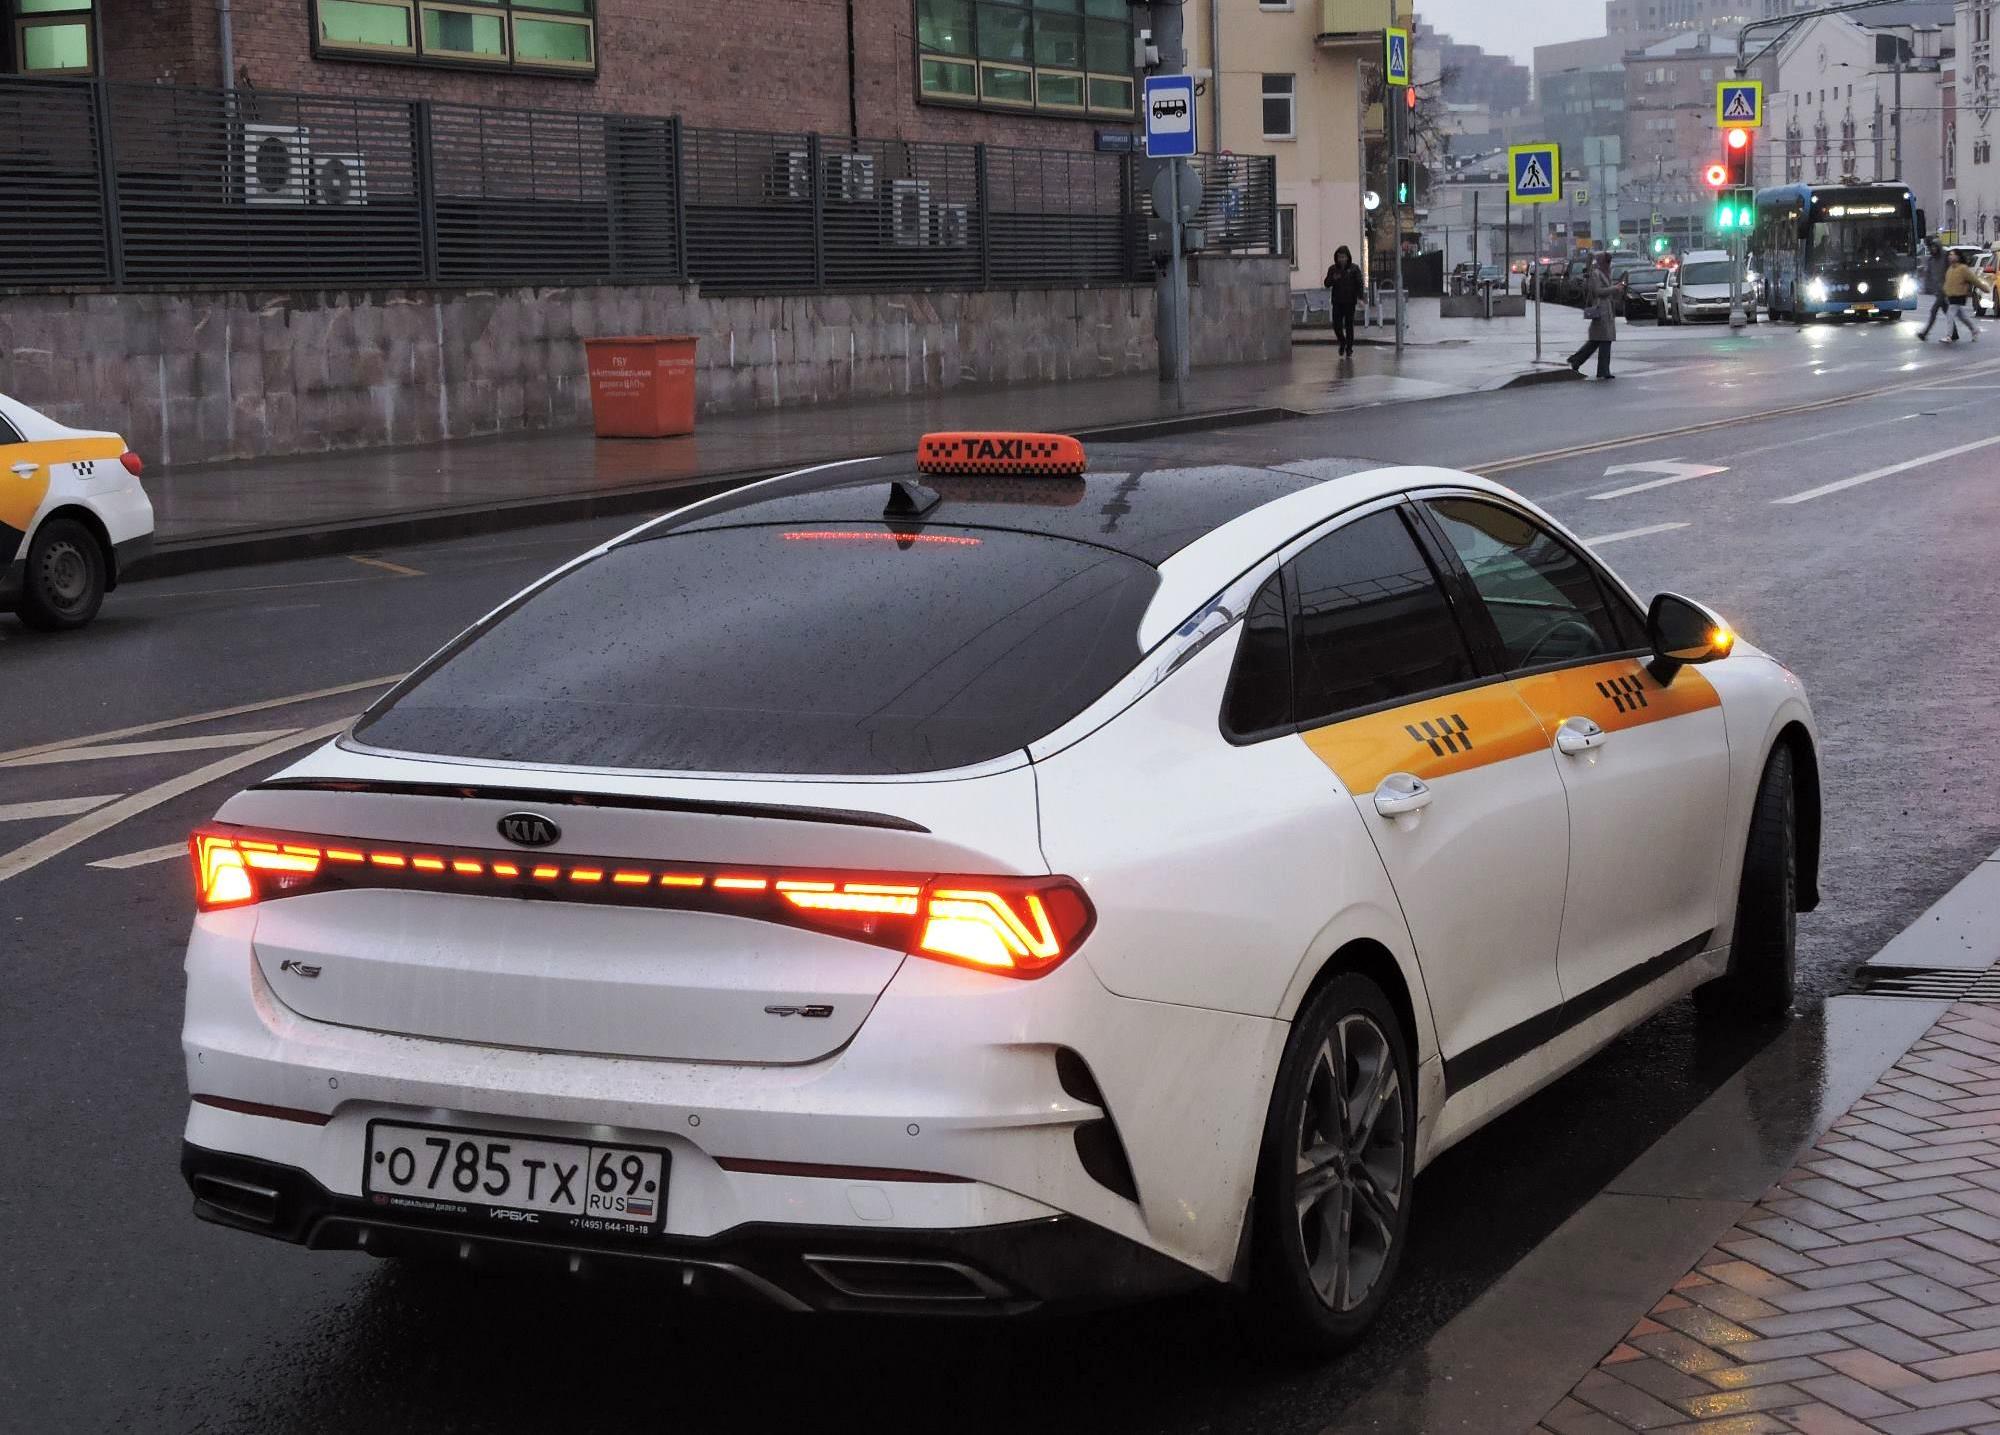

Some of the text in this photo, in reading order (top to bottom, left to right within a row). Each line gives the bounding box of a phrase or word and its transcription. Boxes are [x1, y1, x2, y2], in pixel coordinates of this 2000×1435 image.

[962, 439, 1023, 460] TAXI
[504, 819, 549, 842] KIA
[594, 1152, 645, 1196] 69
[590, 1195, 625, 1212] RUS
[490, 1208, 539, 1223] ИРБИС
[570, 1219, 649, 1234] +7 (495) 644-18-18
